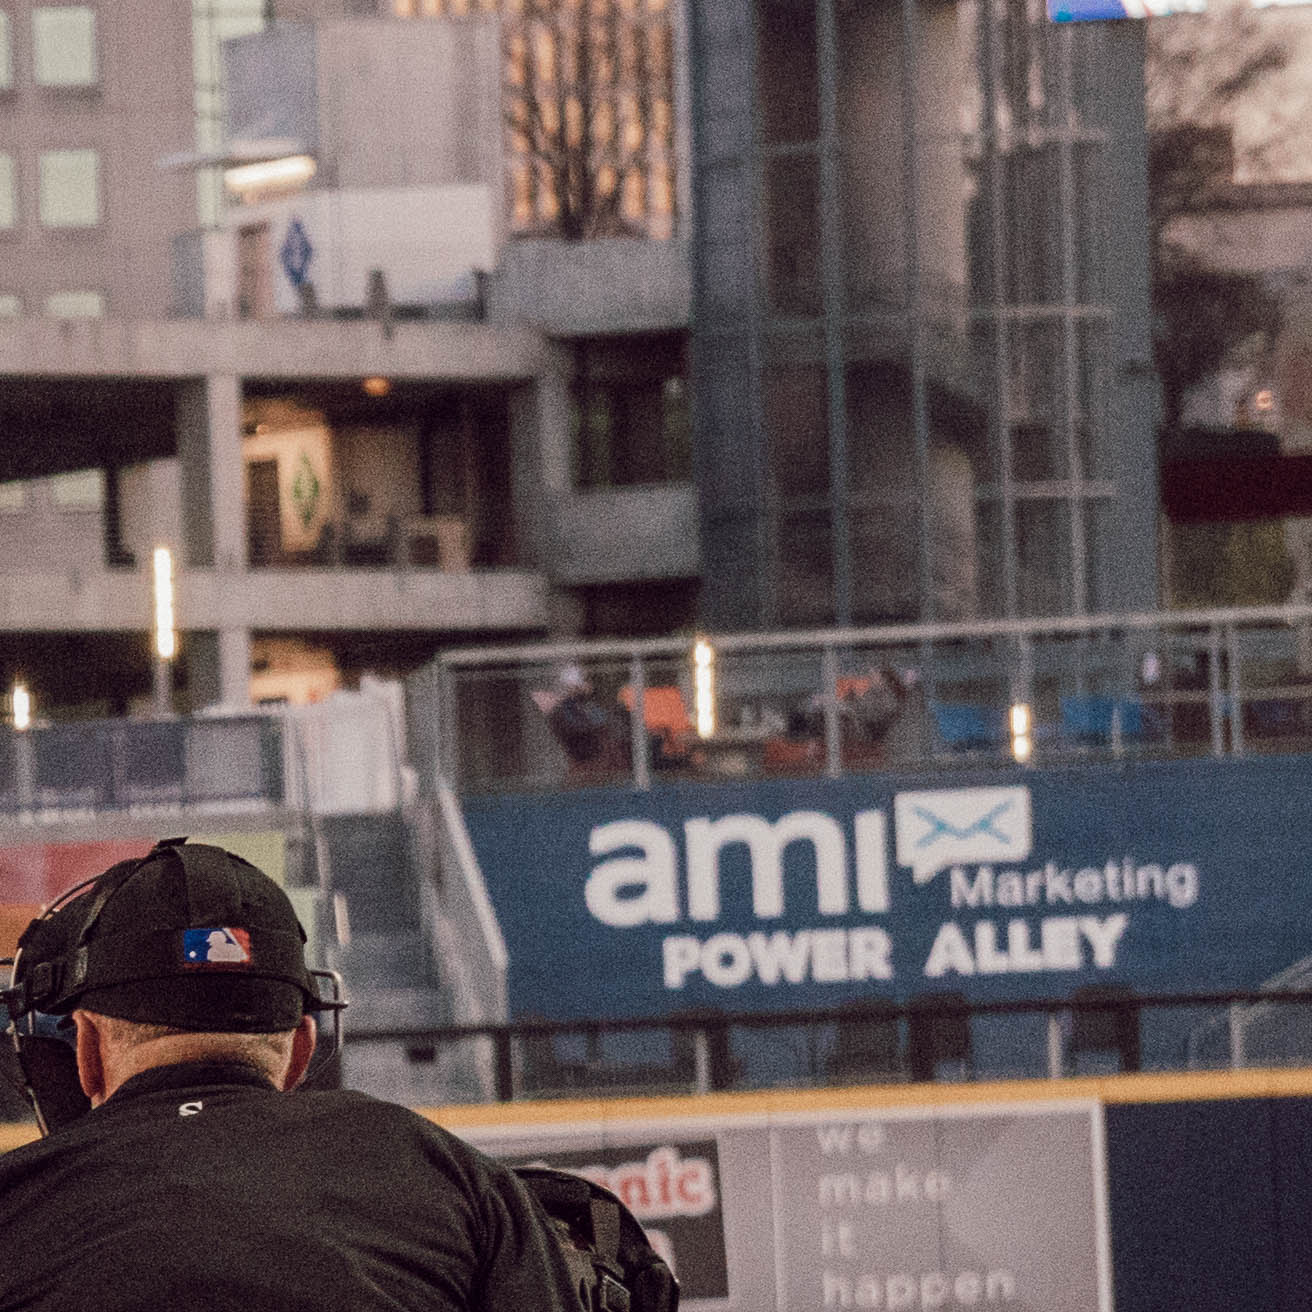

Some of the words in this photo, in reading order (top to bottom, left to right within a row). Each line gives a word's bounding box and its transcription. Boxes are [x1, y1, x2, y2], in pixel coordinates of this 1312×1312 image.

[585, 808, 890, 927] ami
[949, 857, 1199, 908] Marketing
[663, 928, 893, 988] POWER
[925, 914, 1128, 976] ALLEY
[817, 1125, 884, 1153] we
[819, 1167, 951, 1201] make
[823, 1218, 856, 1256] it
[824, 1269, 1016, 1310] happen
